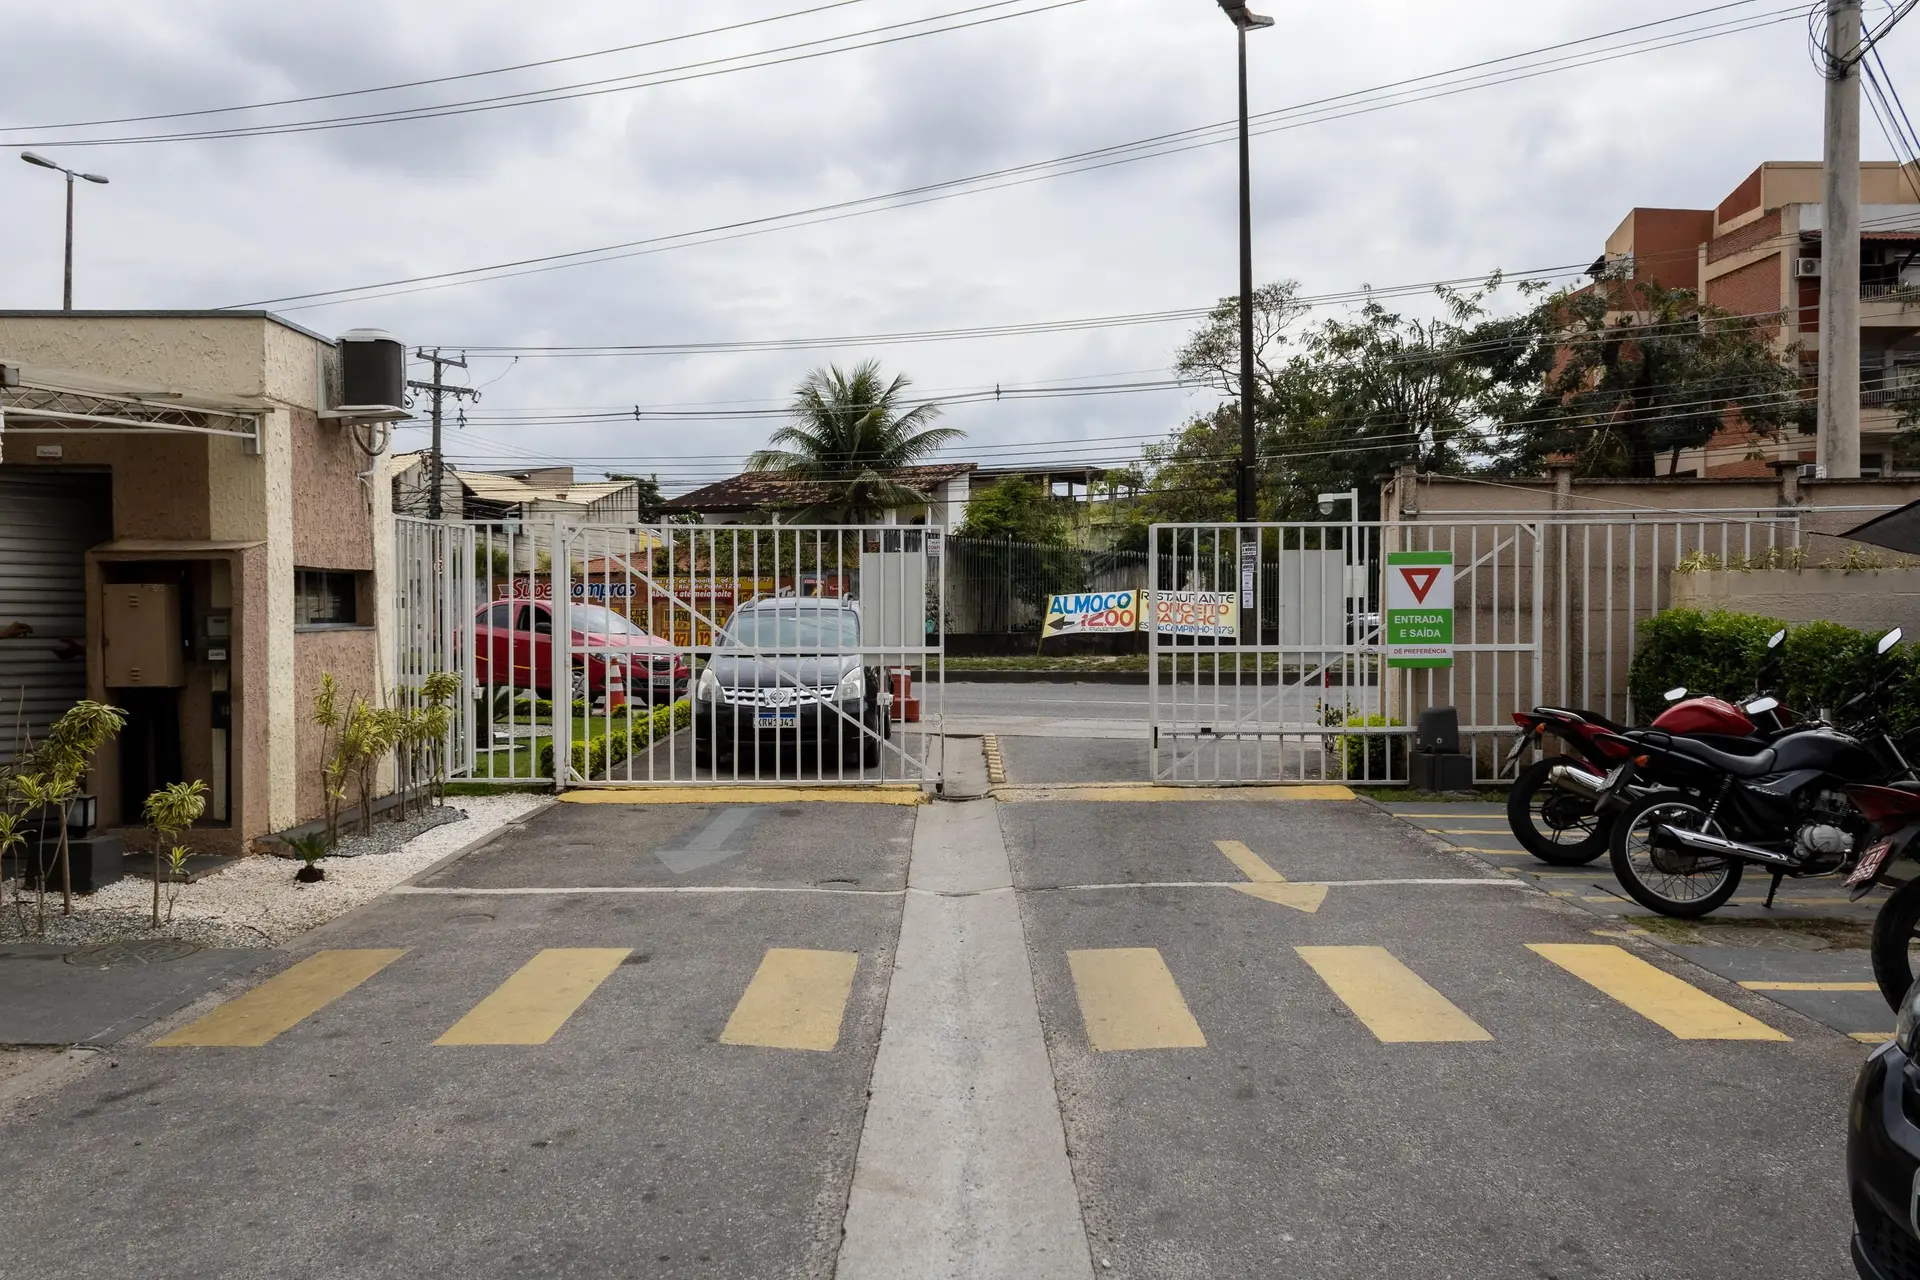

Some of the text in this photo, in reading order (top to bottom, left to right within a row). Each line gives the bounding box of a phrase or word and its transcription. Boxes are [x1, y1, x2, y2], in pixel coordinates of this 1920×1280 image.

[512, 578, 553, 600] Supe
[1140, 591, 1235, 604] RSTAURANTE
[1147, 601, 1230, 615] ONCEITO
[1394, 615, 1444, 624] ENTRADA
[1400, 627, 1441, 638] E SAÍDA
